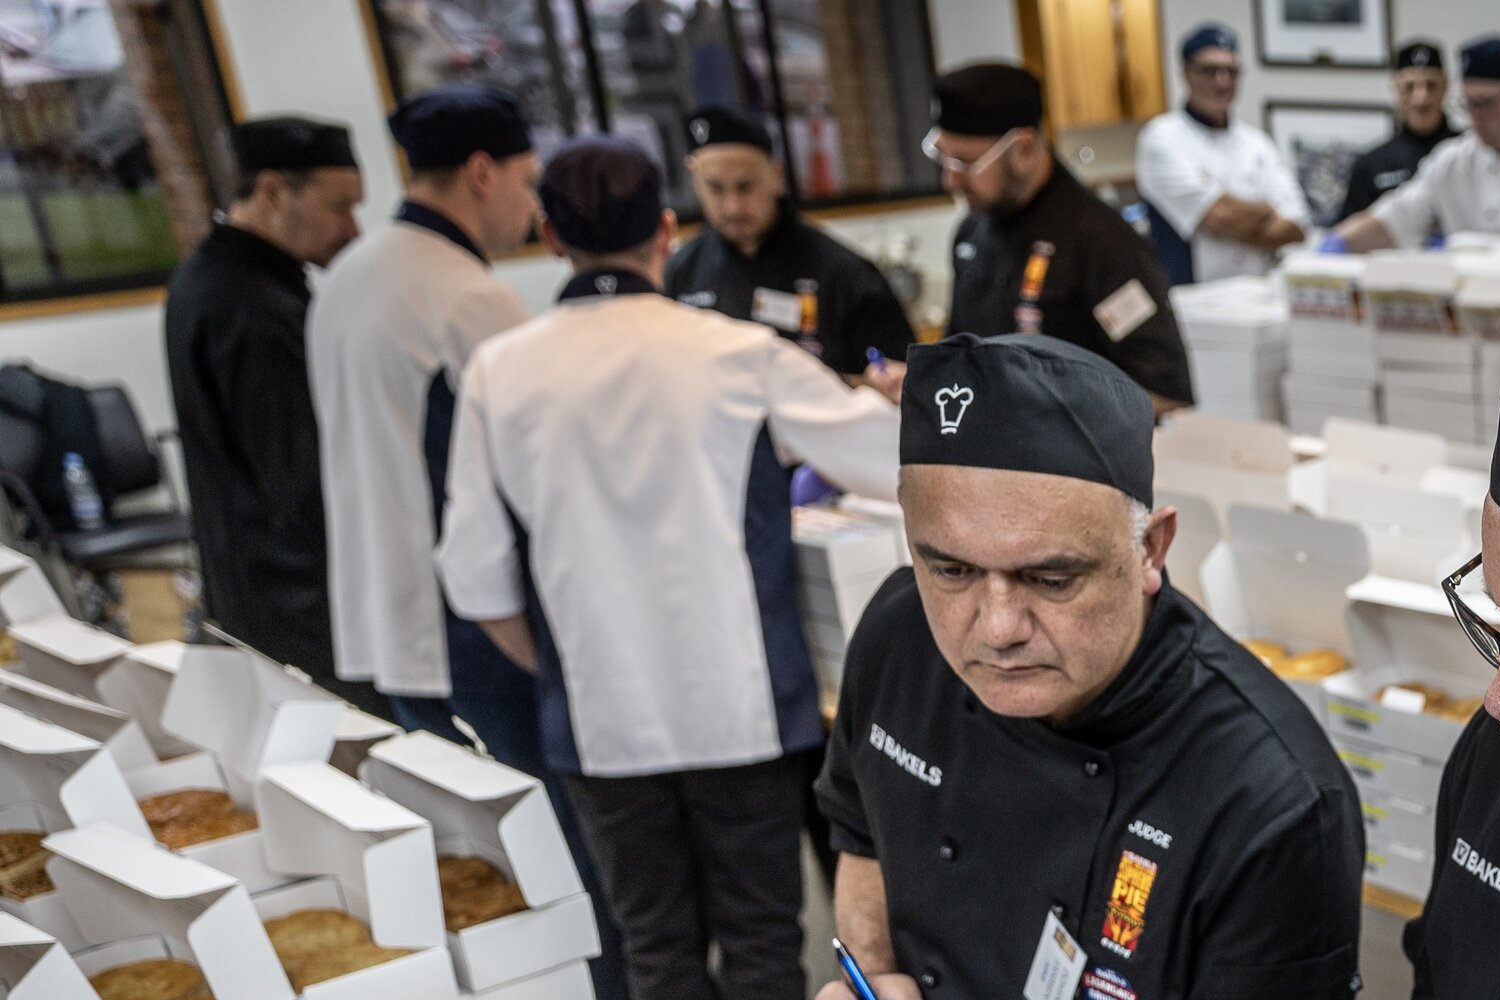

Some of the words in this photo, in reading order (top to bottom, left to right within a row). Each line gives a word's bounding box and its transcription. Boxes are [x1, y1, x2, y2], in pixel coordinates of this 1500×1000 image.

[883, 735, 943, 786] BAKELS
[1128, 820, 1173, 849] JUDGE
[1112, 879, 1148, 912] PIE
